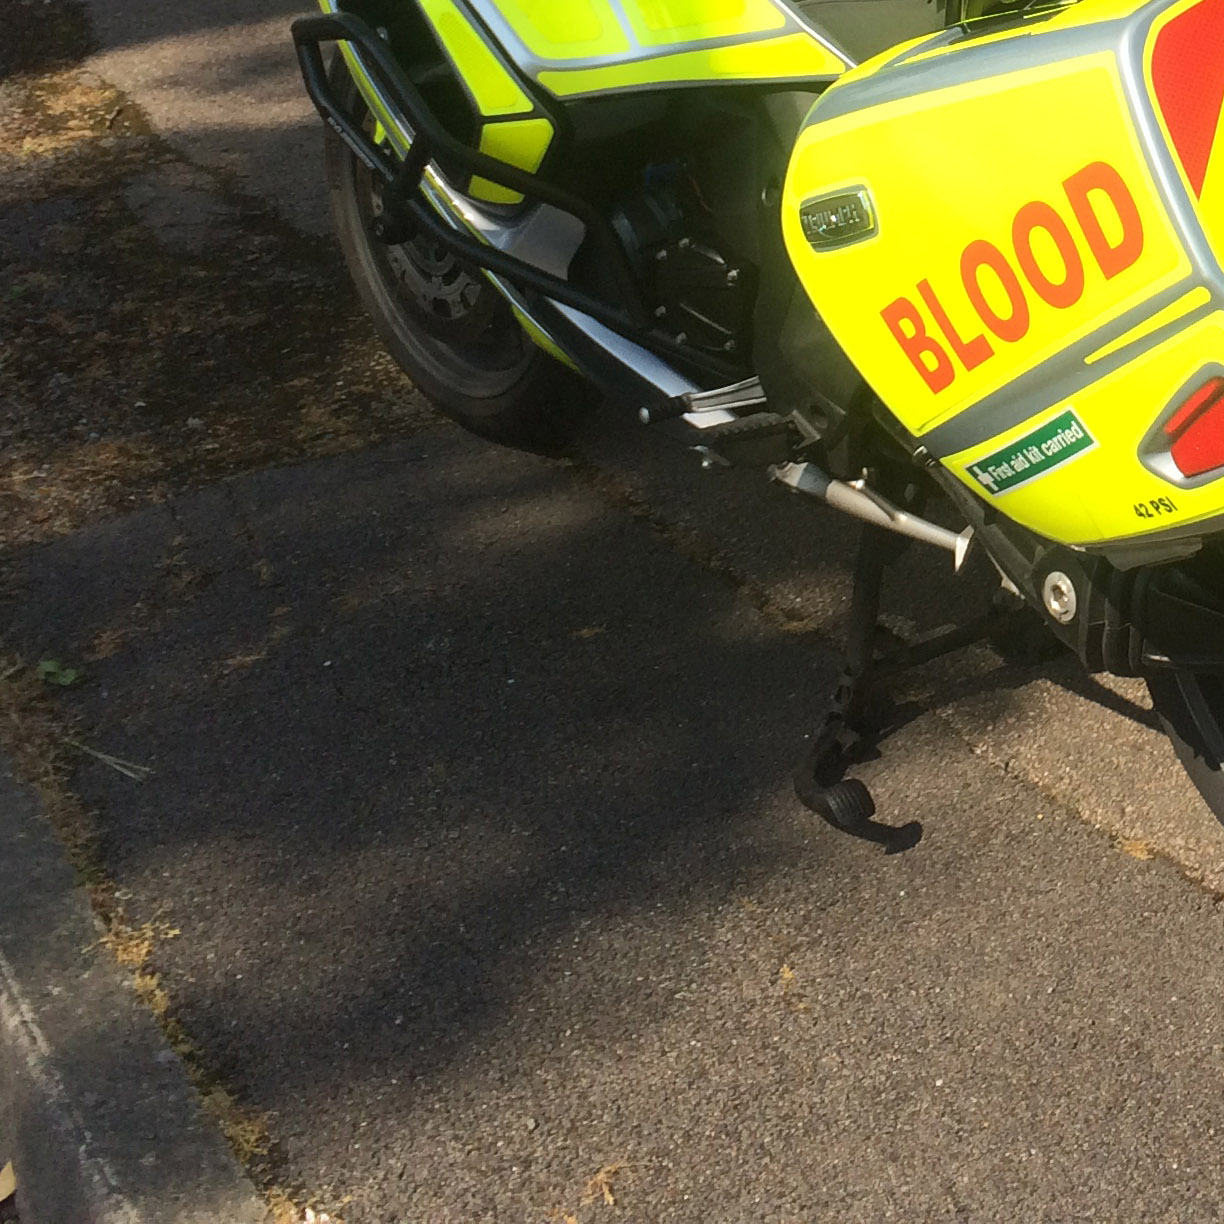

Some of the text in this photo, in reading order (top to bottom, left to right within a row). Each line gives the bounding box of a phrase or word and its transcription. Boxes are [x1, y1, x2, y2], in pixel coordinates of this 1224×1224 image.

[880, 161, 1144, 395] BLOOD
[987, 420, 1085, 482] First aid kit carried
[1133, 495, 1178, 519] 42 PSI
